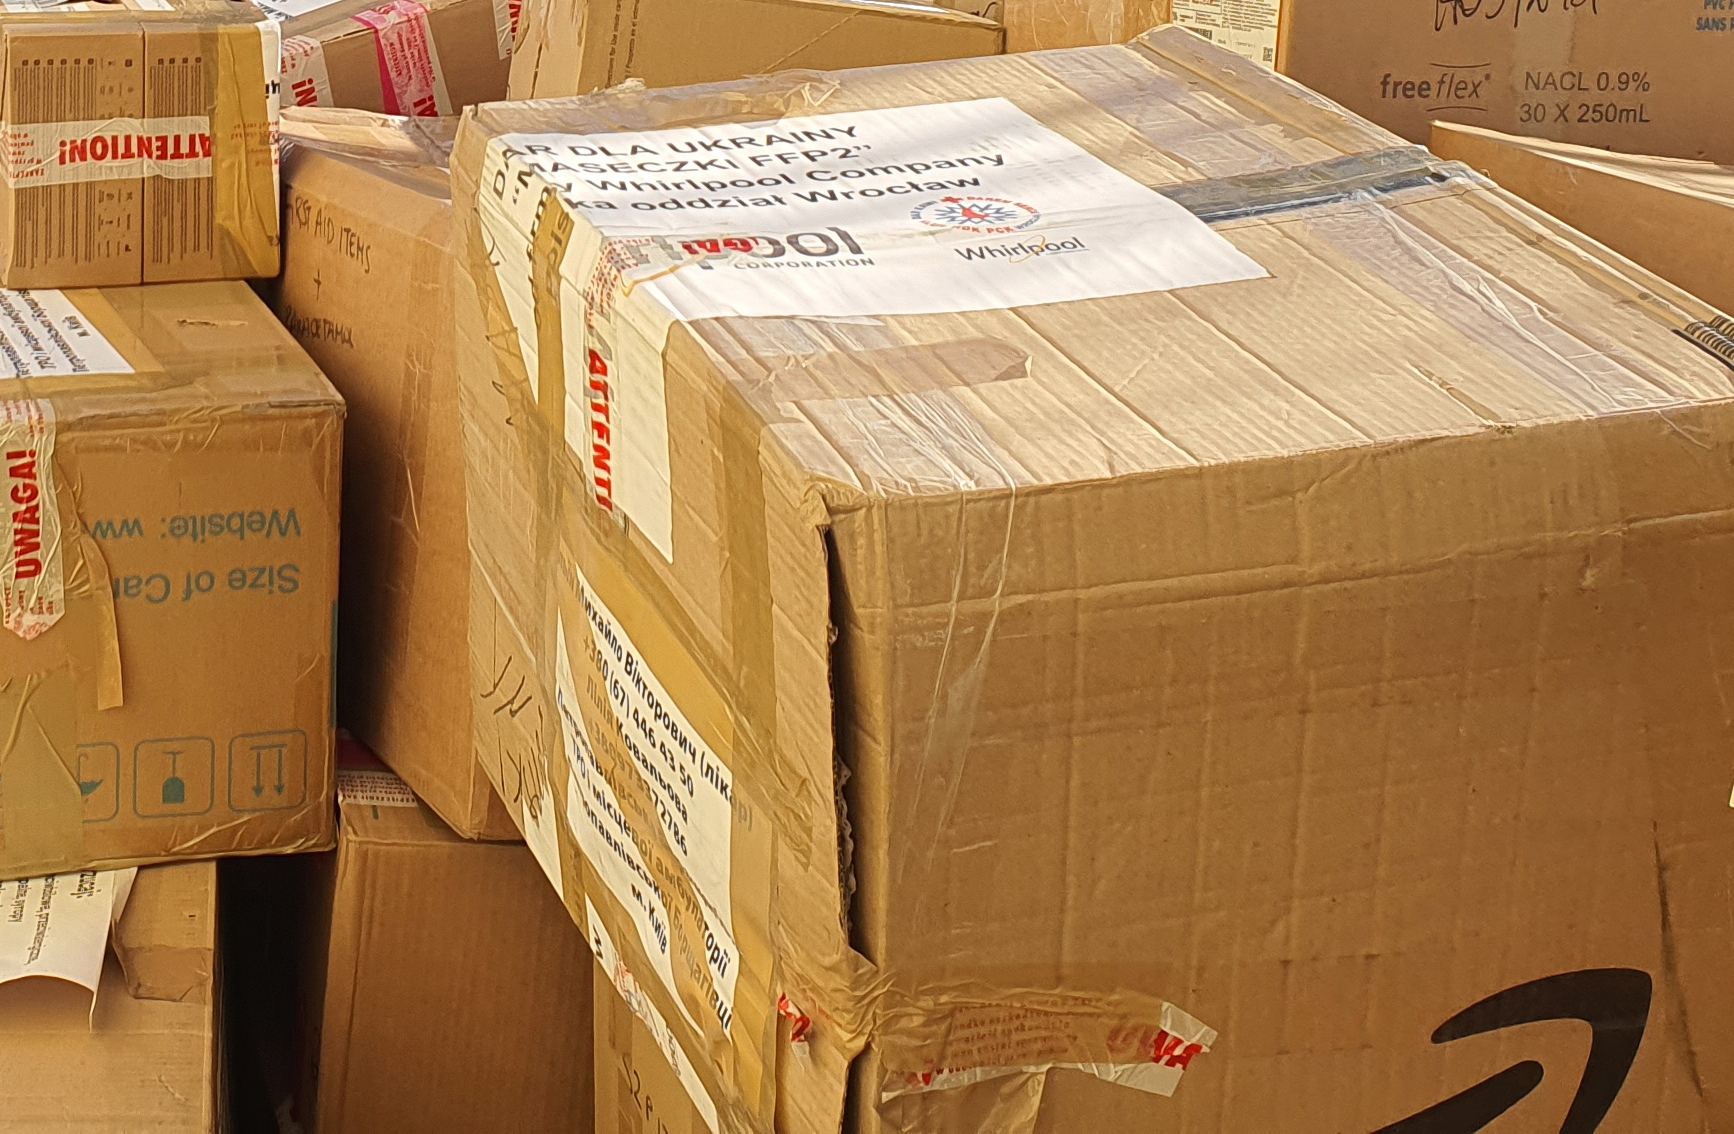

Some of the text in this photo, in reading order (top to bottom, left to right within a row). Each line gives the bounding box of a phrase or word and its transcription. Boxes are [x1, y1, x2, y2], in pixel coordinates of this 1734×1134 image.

[1524, 70, 1651, 93] NACL 0.9%
[1519, 103, 1651, 124] 30 X 250mL
[59, 133, 212, 165] ATTENTION!
[493, 125, 858, 200] DAR DLA UKRAINY
[585, 171, 797, 194] Whirlpool
[806, 153, 1005, 182] Company
[630, 194, 788, 213] oddział
[792, 177, 981, 204] Wrocław
[954, 236, 1087, 262] Whirlpool
[6, 448, 42, 580] UWAGA!
[161, 508, 302, 540] Website:
[185, 567, 216, 603] of
[227, 564, 301, 598] Size
[624, 648, 698, 763] Вікторович
[609, 664, 630, 721] (67)
[632, 698, 656, 753] 446
[659, 736, 676, 775] 43
[680, 762, 695, 799] 50
[616, 714, 689, 823] Ковальова
[582, 799, 673, 911] опавлівської
